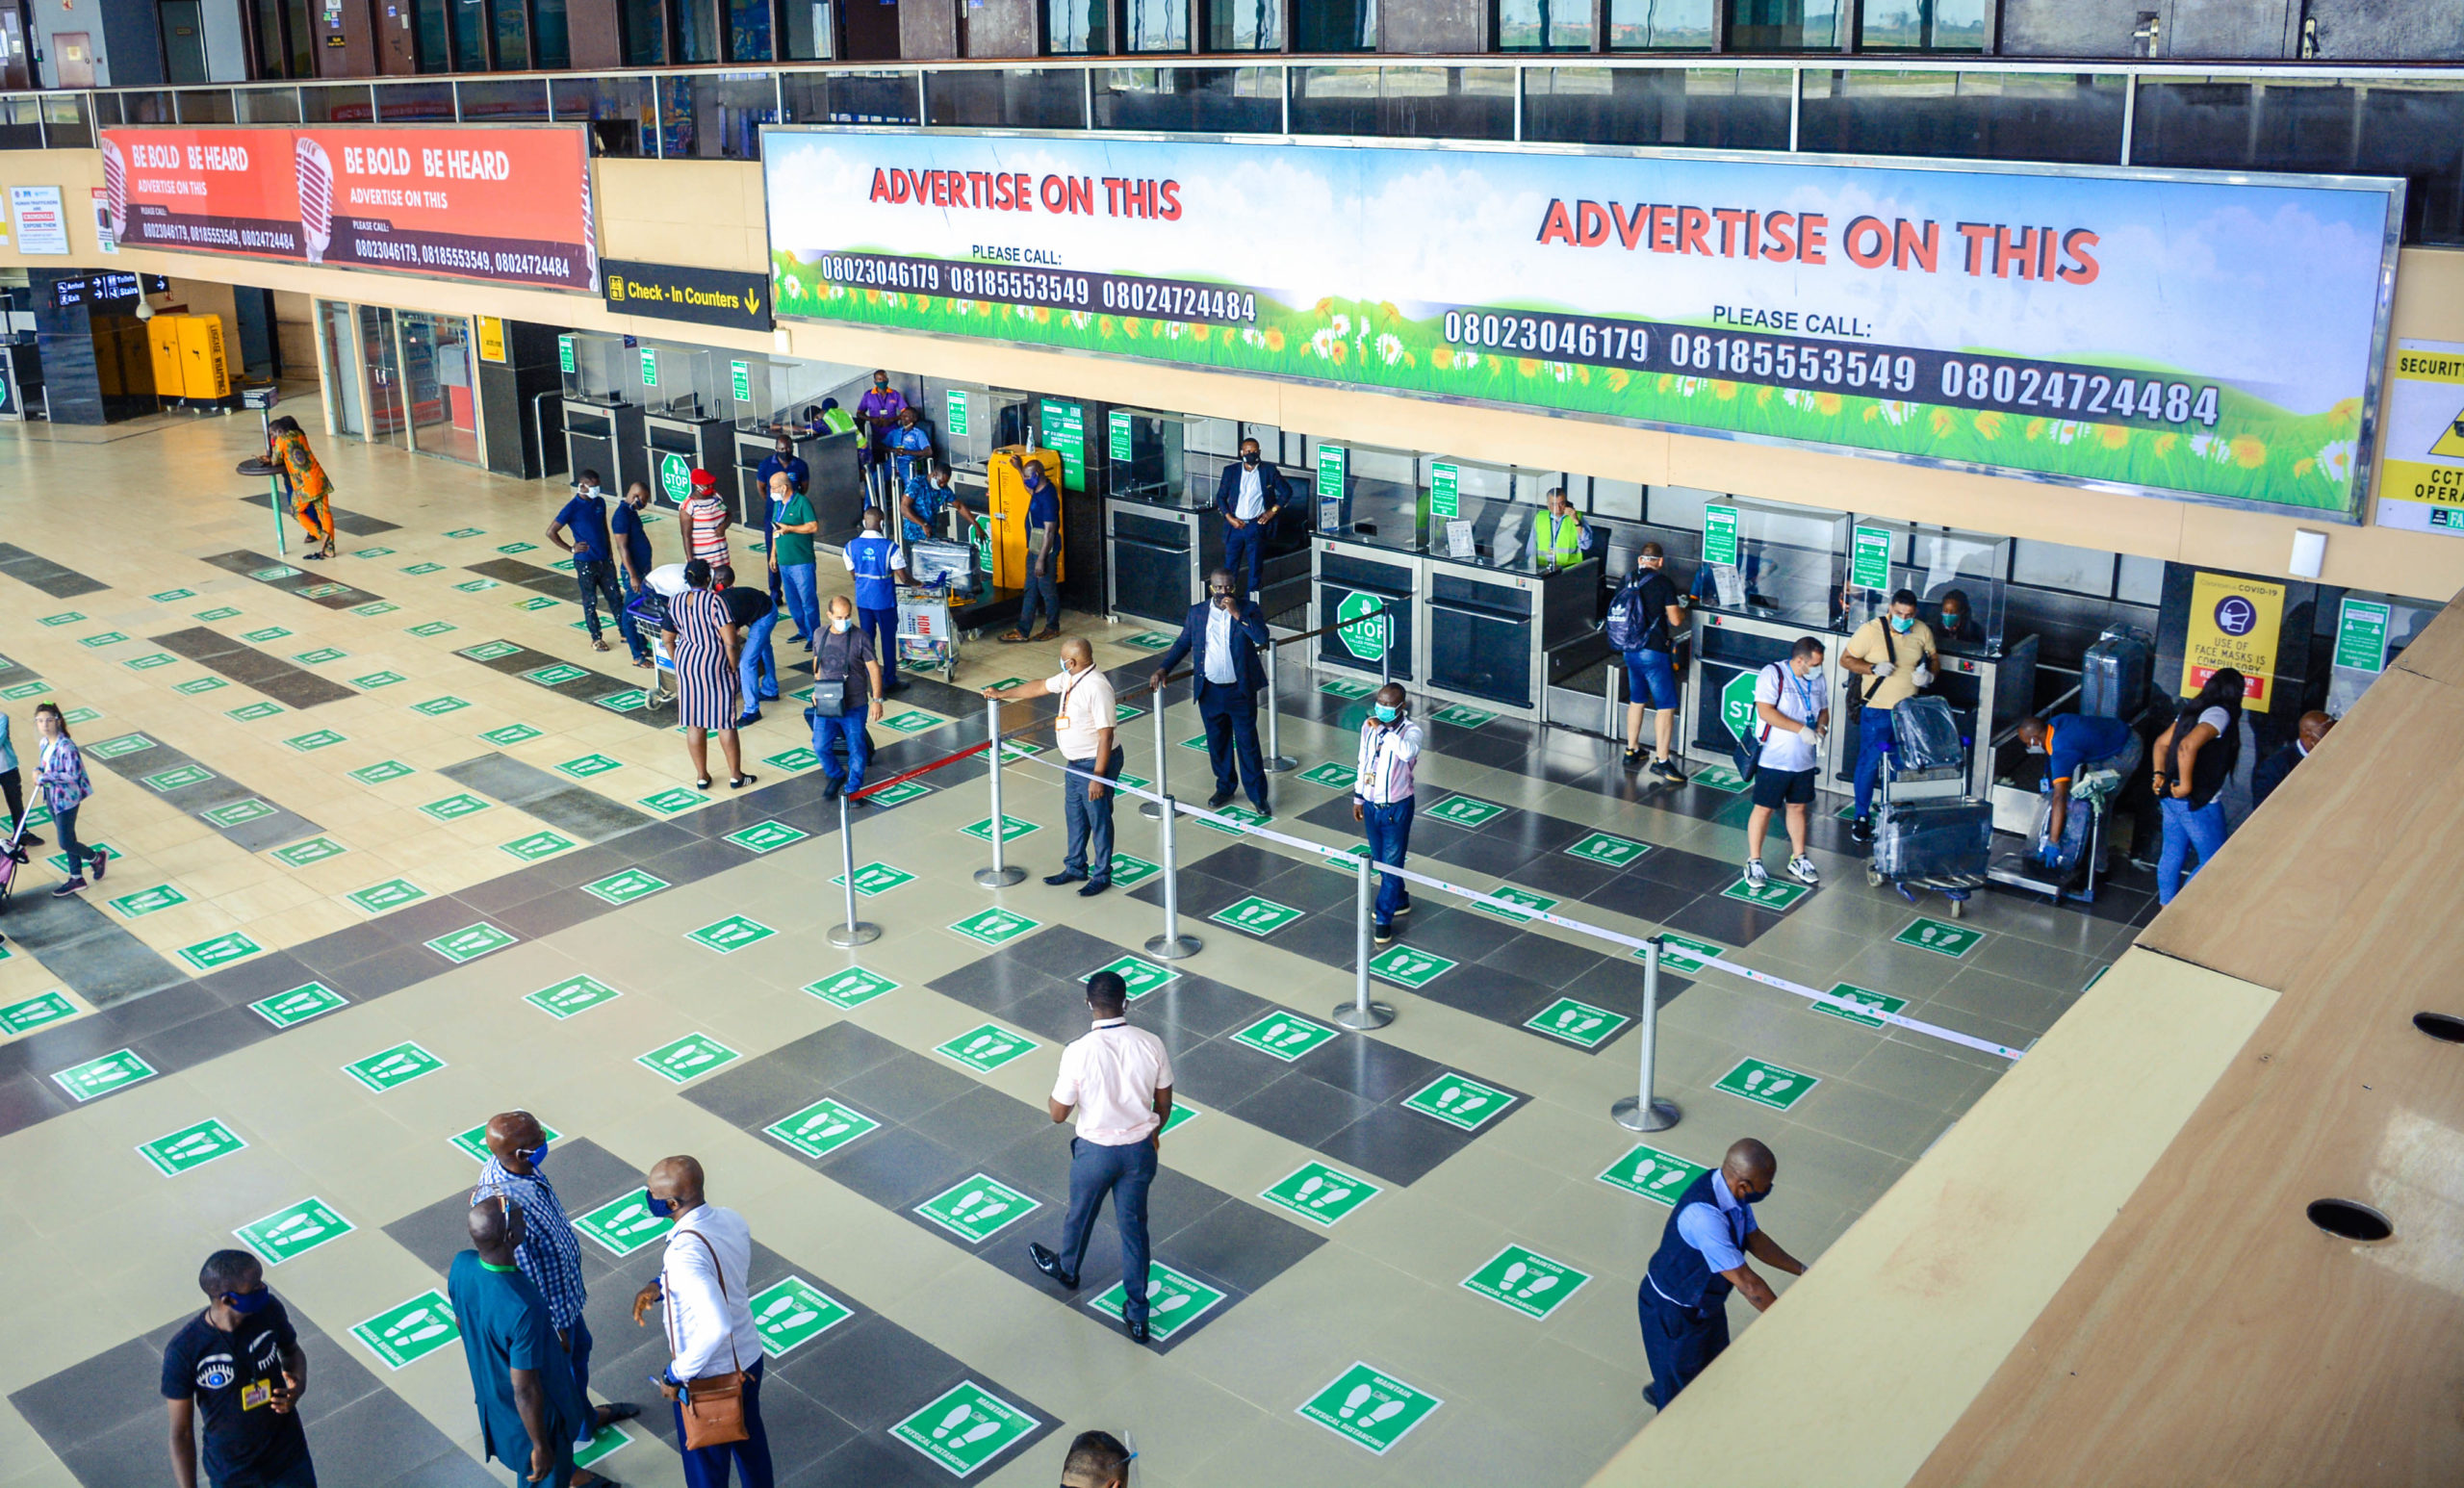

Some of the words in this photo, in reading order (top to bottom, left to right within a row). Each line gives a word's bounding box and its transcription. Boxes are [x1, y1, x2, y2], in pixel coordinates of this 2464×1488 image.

[133, 144, 145, 167] BE
[148, 144, 181, 169] BOLD
[187, 146, 204, 169] BE
[204, 146, 248, 171] HEARD
[345, 146, 364, 174] BE
[367, 146, 411, 175] BOLD
[424, 148, 445, 177] BE
[447, 149, 509, 181] HEARD
[138, 179, 175, 193] ADVERTISE
[177, 181, 189, 194] ON
[189, 182, 208, 196] THIS
[350, 188, 402, 206] ADVERTISE
[404, 191, 422, 208] ON
[424, 192, 449, 209] THIS
[869, 167, 1034, 213] ADVERTISE
[1040, 174, 1093, 216] ON
[1101, 175, 1184, 221] THIS
[352, 219, 372, 231] PLEASE
[373, 221, 389, 233] CALL:
[242, 229, 295, 250] 08024724484
[1536, 198, 1829, 266] ADVERTISE
[1843, 215, 1940, 273] ON
[1956, 221, 2101, 285] THIS
[495, 252, 570, 278] 08024724484
[972, 244, 1021, 264] PLEASE
[1024, 246, 1063, 266] CALL:
[119, 287, 139, 296] Stairs
[628, 281, 664, 301] Check
[672, 285, 683, 303] In
[684, 287, 739, 309] Counters
[821, 254, 939, 291] 08023046179
[949, 265, 1090, 306] 08185553549
[1101, 279, 1257, 322] 08024724484
[1713, 305, 1798, 331] PLEASE
[1806, 314, 1872, 338] CALL:
[1445, 310, 1649, 363] 08023046179
[1671, 332, 1915, 393] 08185553549
[1940, 360, 2220, 425] 08024724484
[2400, 358, 2464, 377] SECURIT
[665, 473, 688, 487] STOP
[2239, 584, 2277, 597] COVID-19
[1344, 617, 1383, 639] STOP
[2214, 637, 2233, 649] USE
[2237, 641, 2248, 651] OF
[2194, 645, 2218, 656] FACE
[2221, 649, 2252, 663] MASKS
[2256, 654, 2266, 666] IS
[2196, 656, 2262, 676] COMPULSORY
[1729, 701, 1754, 721] ST
[1527, 1255, 1565, 1274] MAINTAIN
[1373, 1376, 1413, 1398] MAINTAIN
[976, 1397, 1011, 1421] MAINTAIN
[1305, 1405, 1340, 1426] PHYSICAL
[1340, 1421, 1386, 1449] DISTANCING
[899, 1424, 931, 1448] PHYSICAL
[930, 1444, 970, 1471] DISTANCING
